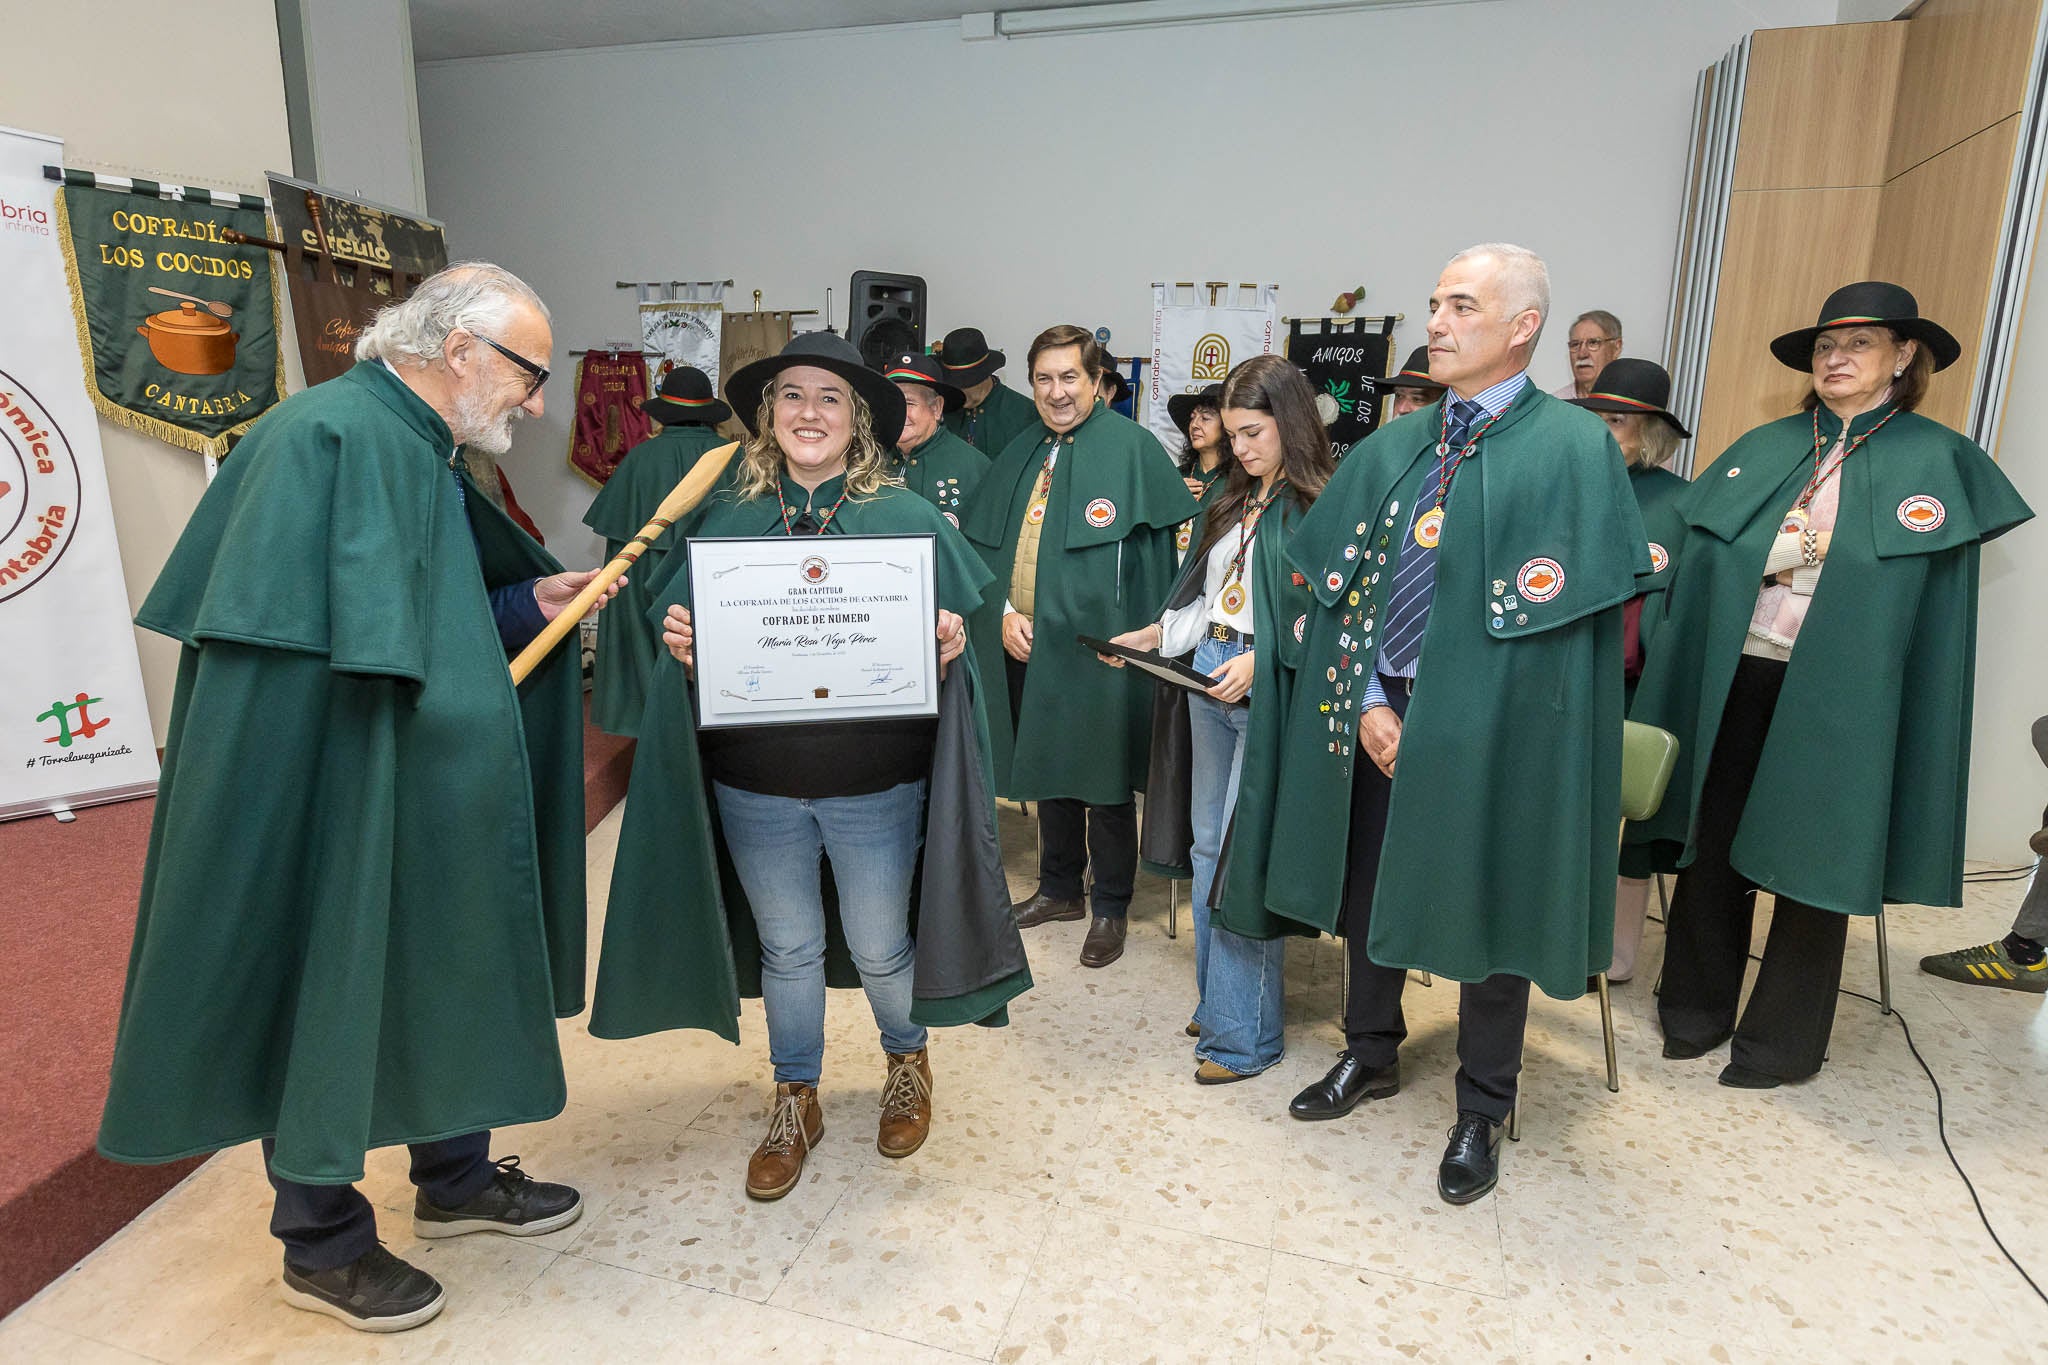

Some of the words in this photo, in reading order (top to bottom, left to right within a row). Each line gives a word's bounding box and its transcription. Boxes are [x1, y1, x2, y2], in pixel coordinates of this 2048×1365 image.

[0, 199, 47, 224] bria
[5, 220, 49, 236] infinita
[301, 228, 391, 262] crculo
[100, 244, 145, 269] LOS
[156, 252, 253, 279] COCIDOS
[1264, 319, 1273, 356] canta
[1311, 346, 1364, 366] AMIGOS
[1361, 375, 1375, 394] DE
[144, 383, 252, 415] CANTABRIA
[1356, 400, 1373, 424] LOS
[0, 391, 55, 475] ómica
[0, 505, 67, 587] ntabria
[720, 600, 731, 608] LA
[780, 598, 791, 606] DE
[793, 597, 809, 605] LOS
[810, 596, 847, 604] COCIDOS
[861, 594, 909, 603] CANTABRIA
[788, 587, 807, 596] GRAN
[809, 586, 843, 595] CAPÍTULO
[762, 615, 809, 626] COFRADE
[812, 614, 825, 624] DE
[828, 612, 870, 624] NÚMERO
[757, 635, 792, 649] María
[794, 634, 818, 647] Rosa
[821, 632, 846, 650] Vega
[848, 632, 877, 645] Pérez
[26, 758, 36, 769] #
[39, 744, 133, 767] Torrelaveganízate
